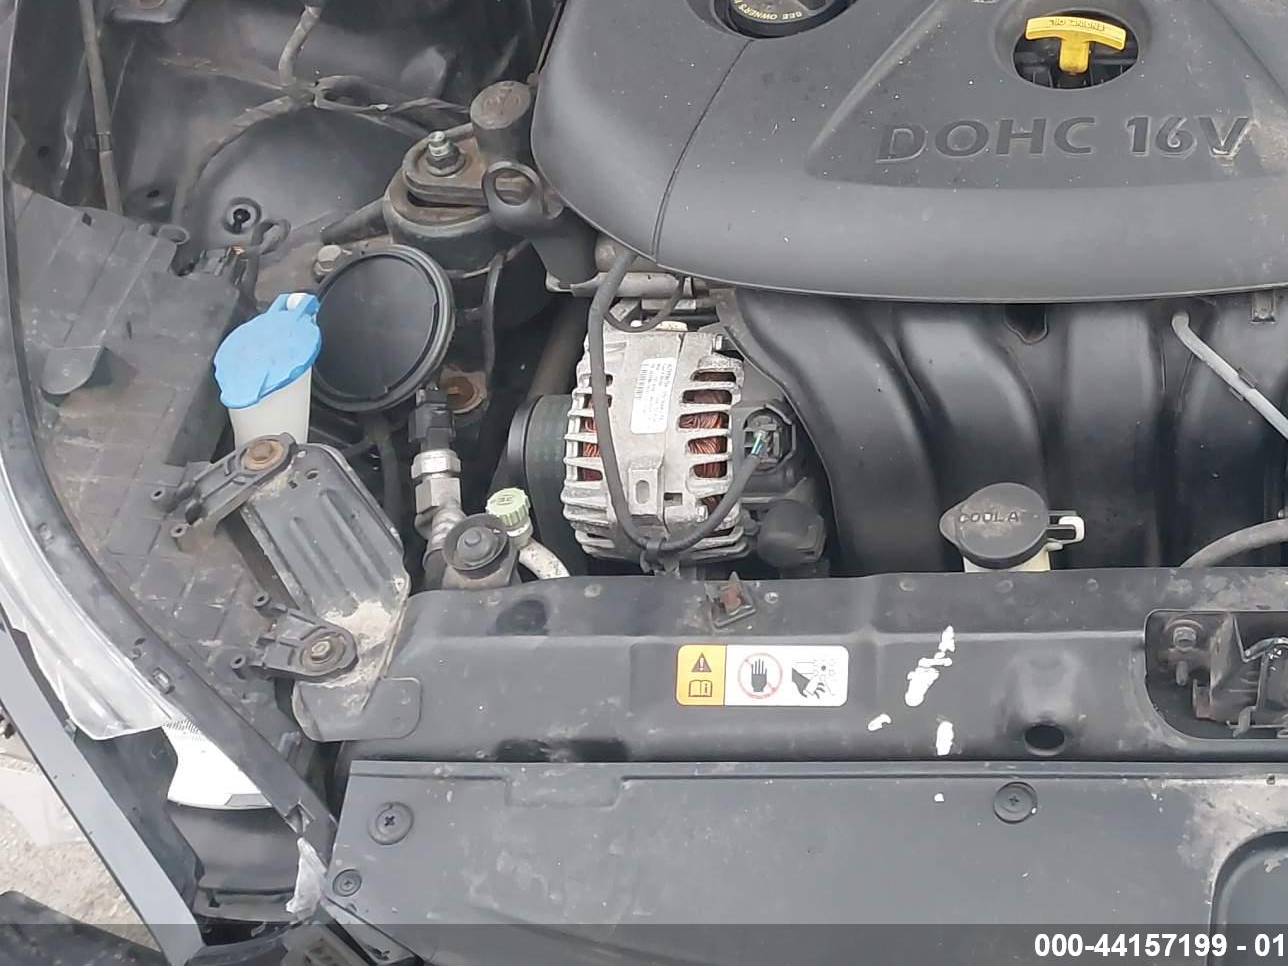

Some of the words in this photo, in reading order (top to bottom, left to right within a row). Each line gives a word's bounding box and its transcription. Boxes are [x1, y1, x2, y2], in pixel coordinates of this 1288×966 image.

[782, 10, 802, 20] SEE
[876, 116, 1098, 163] DOHC
[1125, 115, 1253, 160] 16V
